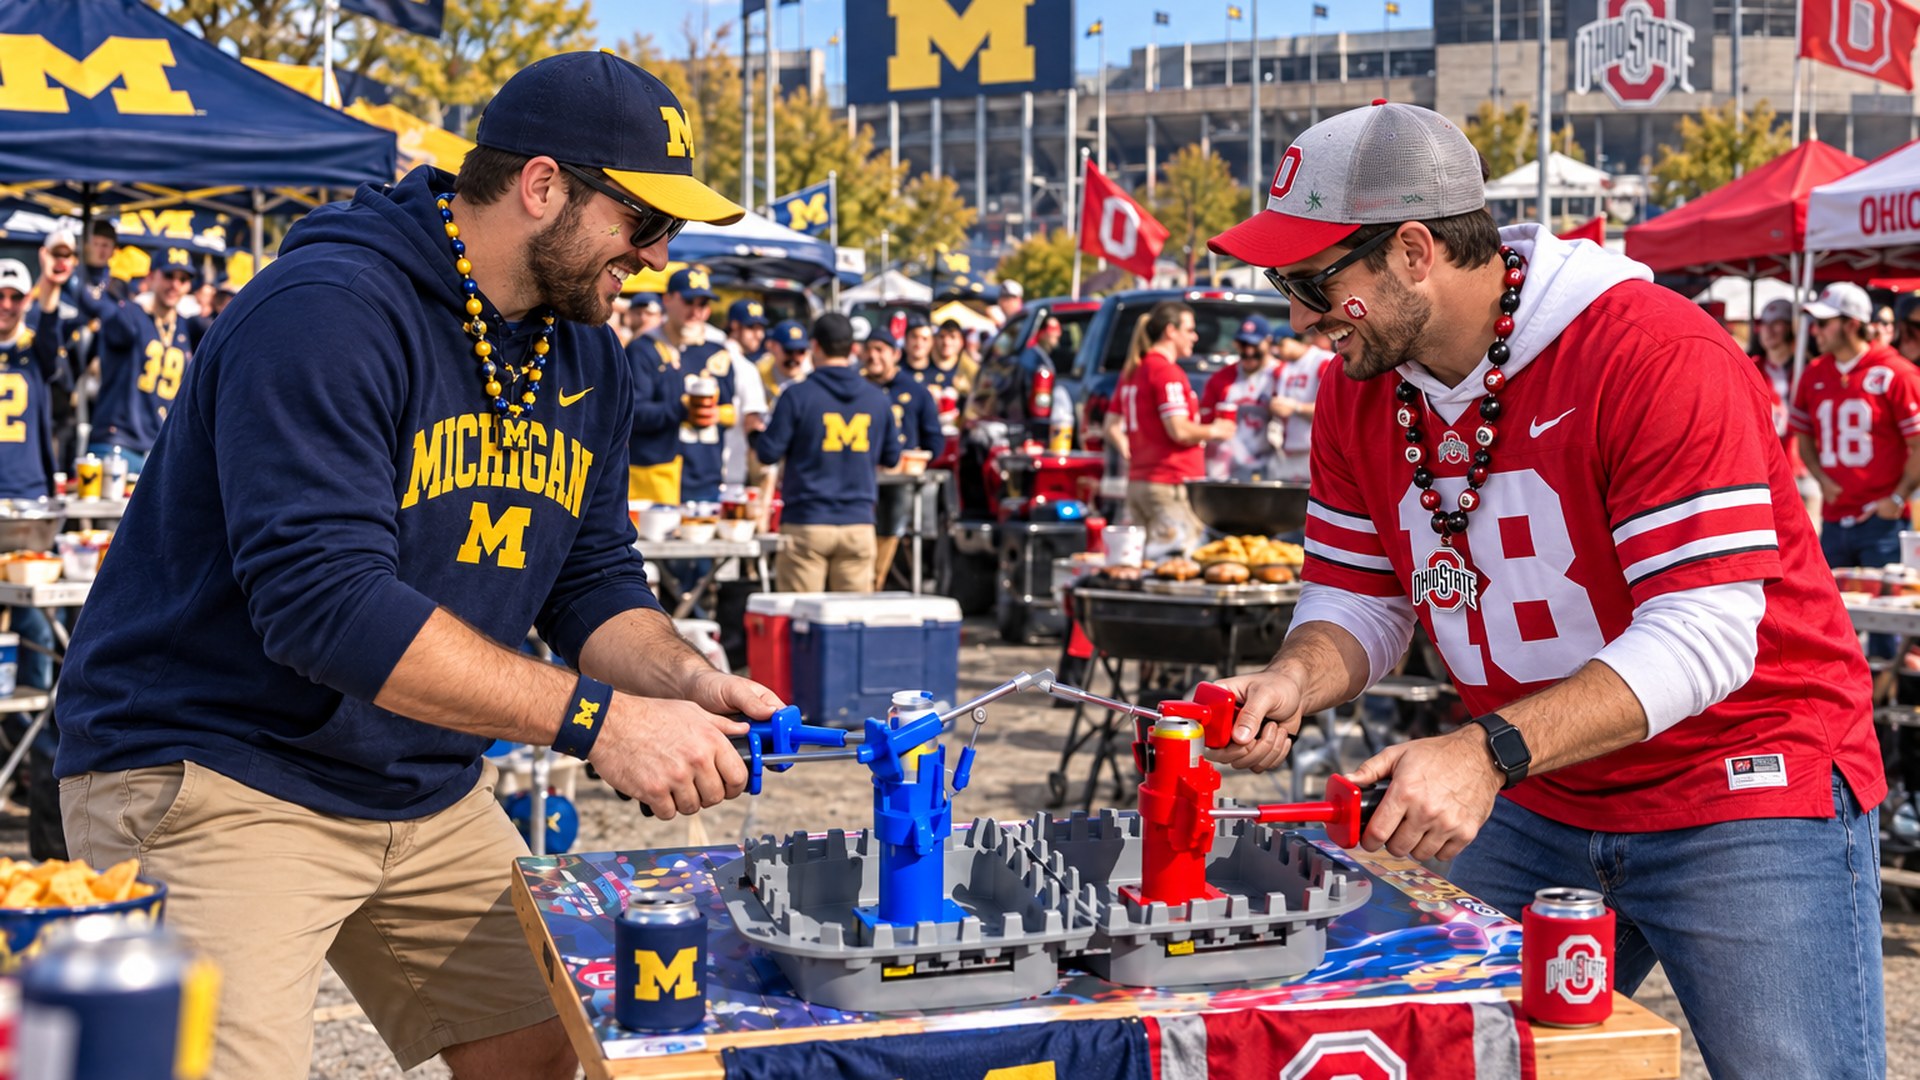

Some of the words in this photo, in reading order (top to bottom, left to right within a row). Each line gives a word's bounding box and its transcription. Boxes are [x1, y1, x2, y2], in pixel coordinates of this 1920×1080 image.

[887, 0, 1036, 91] M
[1829, 0, 1893, 74] O
[0, 34, 196, 116] M
[659, 106, 695, 158] M
[1269, 145, 1304, 201] O
[787, 193, 829, 230] M
[1100, 196, 1141, 260] O
[137, 340, 185, 400] 39
[502, 418, 529, 448] M
[822, 412, 871, 452] M
[1816, 398, 1874, 468] 18
[456, 501, 533, 570] M
[1398, 468, 1606, 686] 18
[572, 697, 601, 730] M
[634, 945, 698, 1002] M
